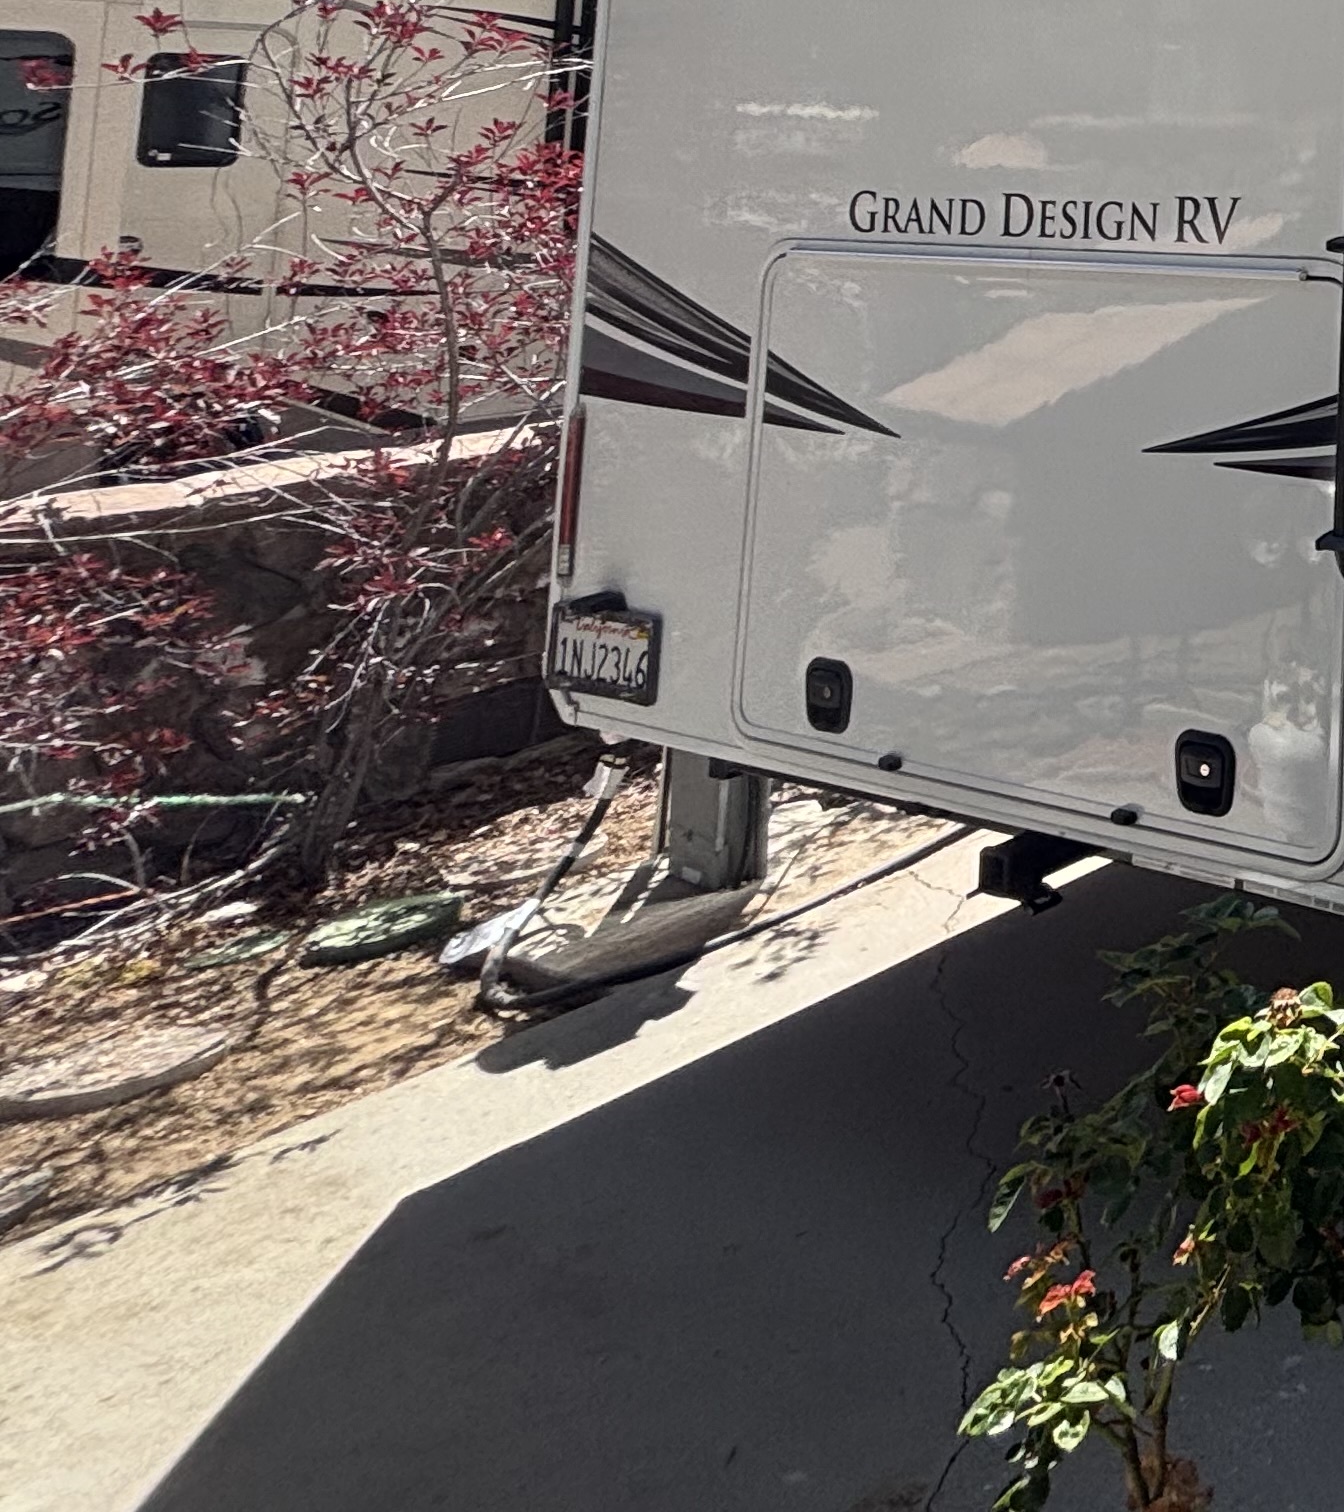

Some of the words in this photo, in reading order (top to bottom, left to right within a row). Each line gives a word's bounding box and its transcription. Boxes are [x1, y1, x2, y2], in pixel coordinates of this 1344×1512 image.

[849, 190, 986, 235] GRAND
[1000, 192, 1160, 243] DESIGN
[1173, 196, 1242, 245] RV
[556, 637, 649, 689] 1NJ2346
